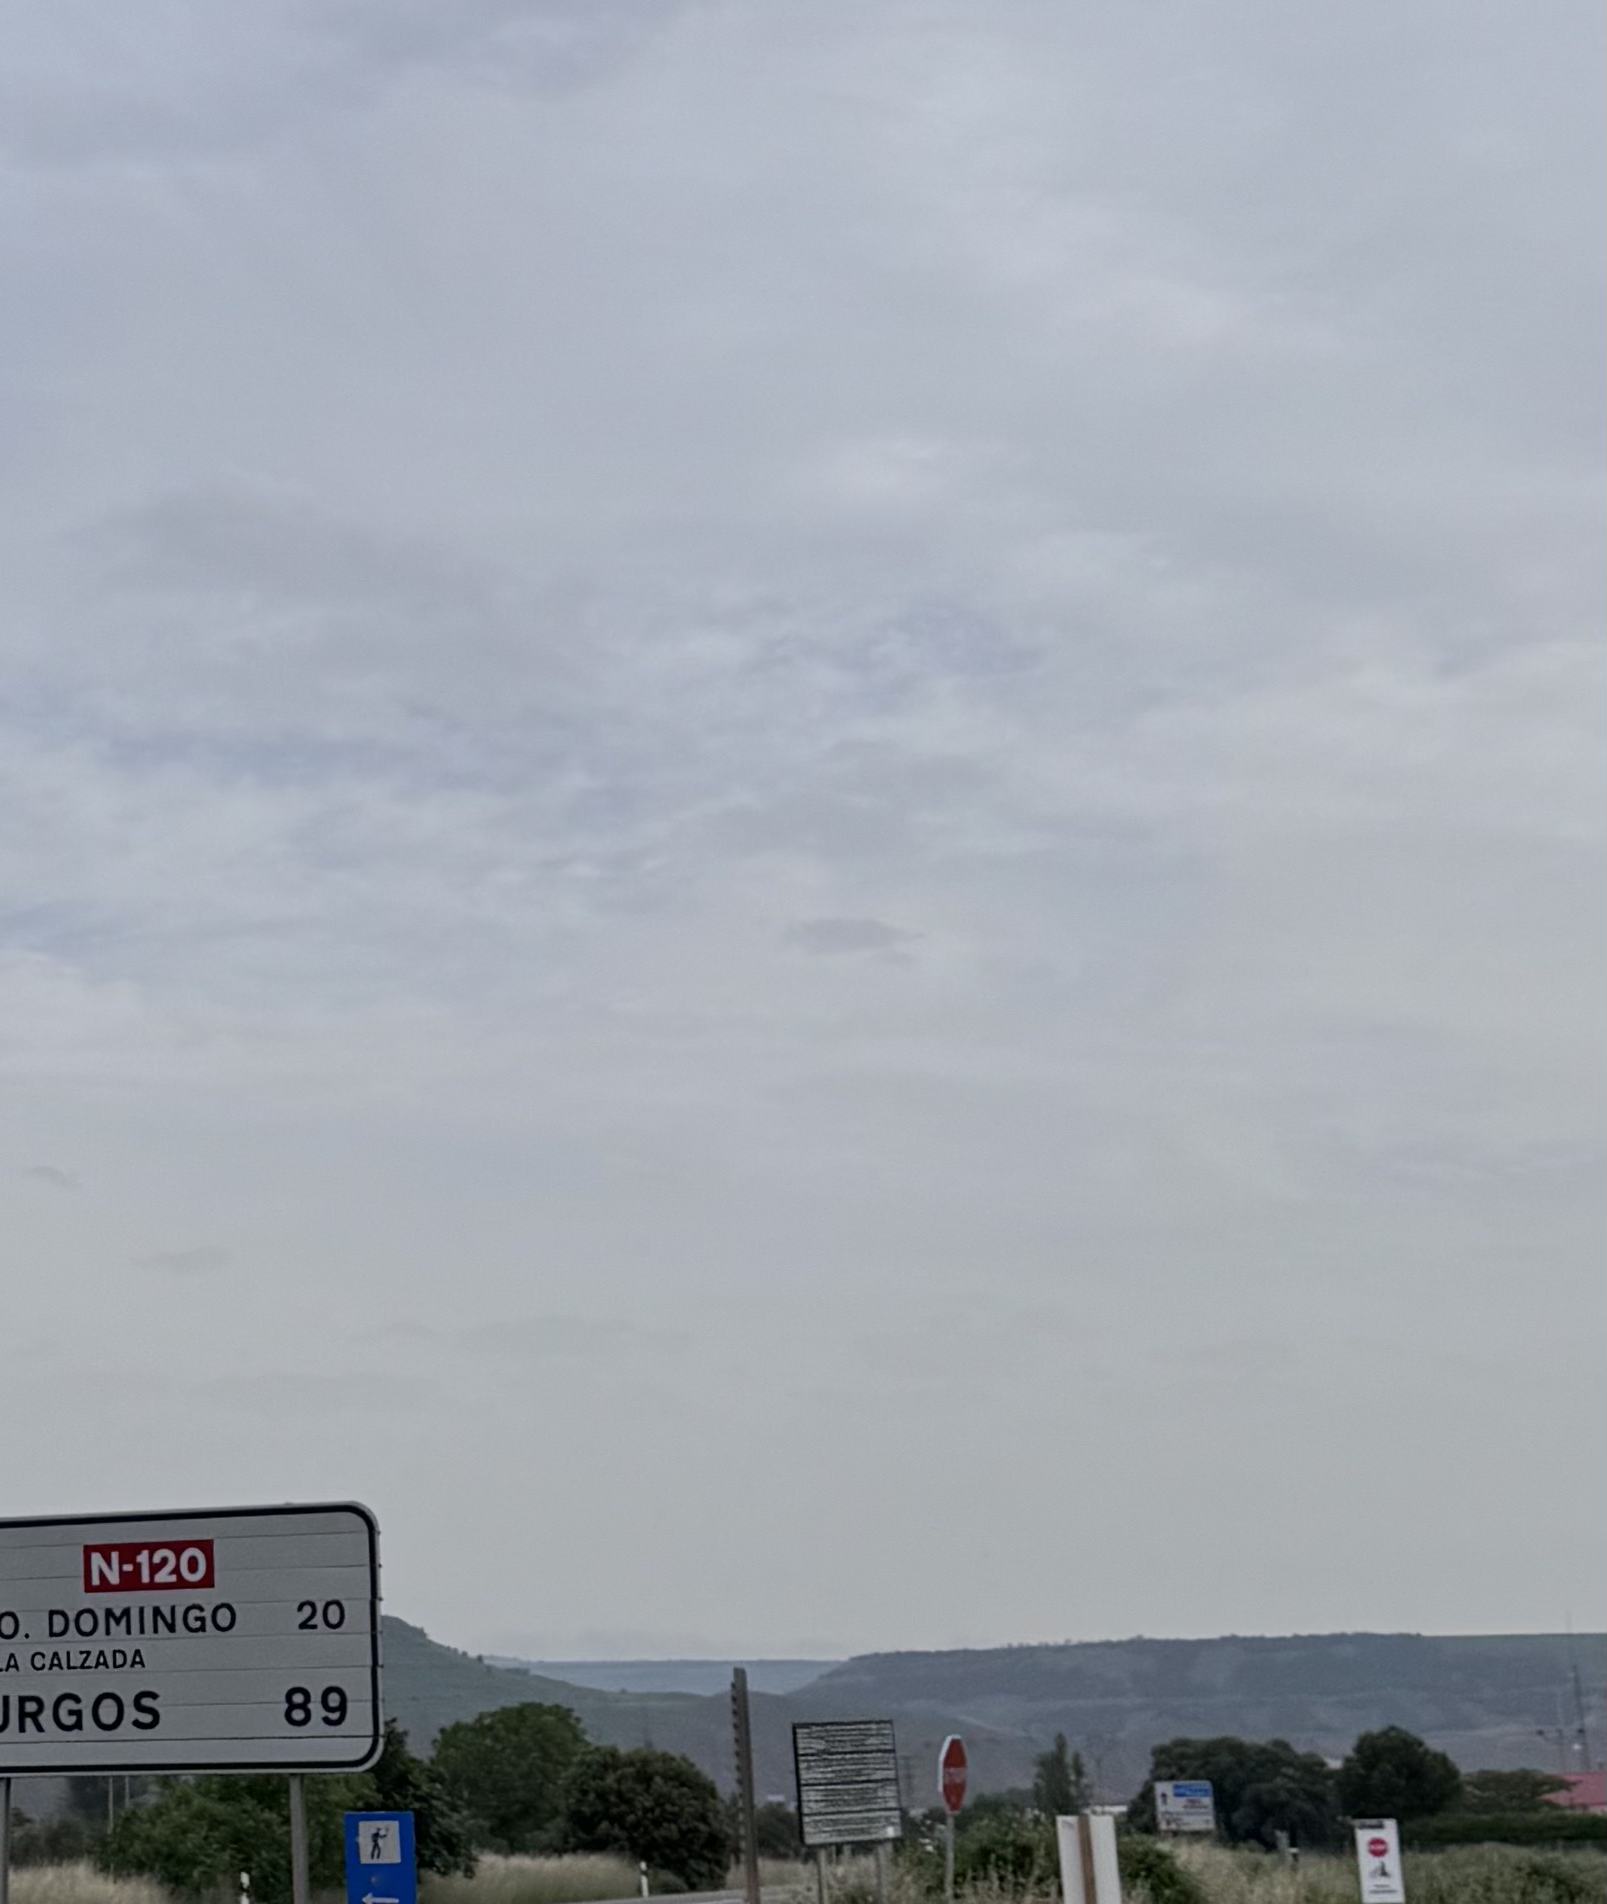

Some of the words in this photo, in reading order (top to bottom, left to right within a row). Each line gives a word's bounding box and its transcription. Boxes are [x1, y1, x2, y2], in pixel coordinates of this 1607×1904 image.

[90, 1548, 207, 1586] N-120
[48, 1602, 237, 1638] DOMINGO
[296, 1600, 346, 1631] 20
[30, 1649, 146, 1672] CALZADA
[284, 1686, 348, 1727] 89
